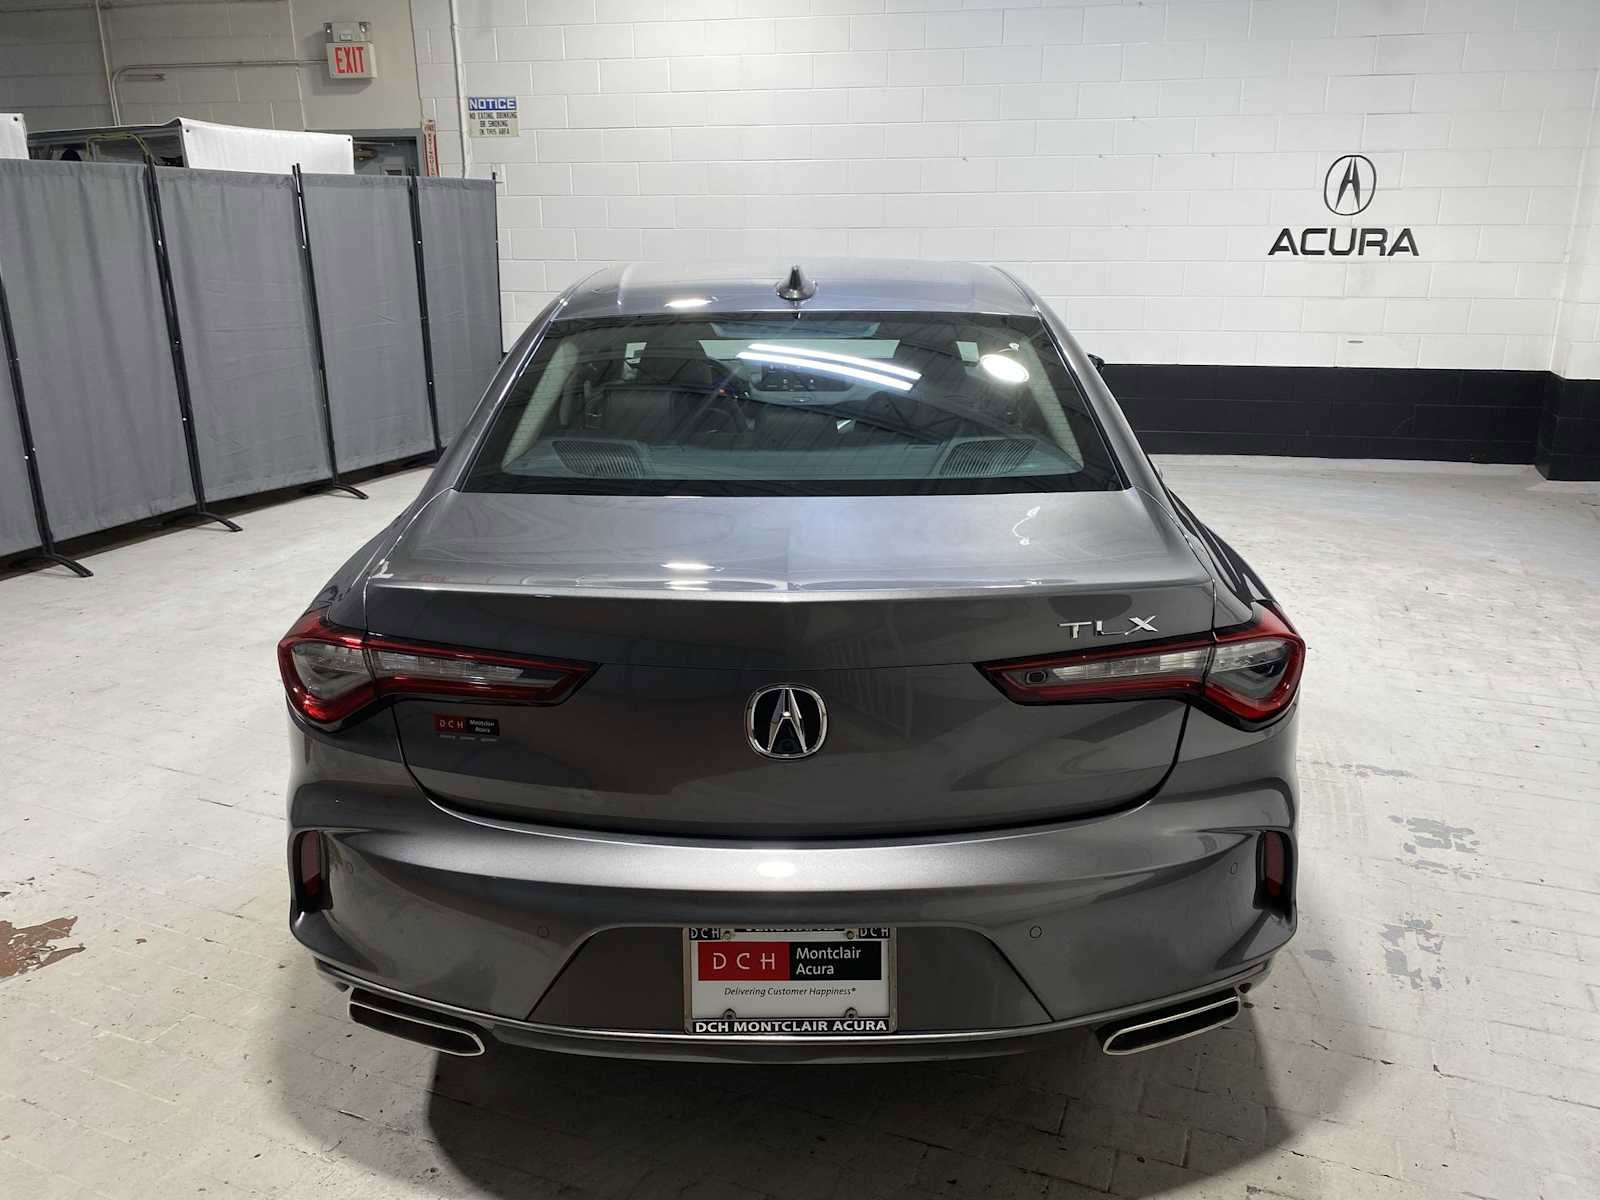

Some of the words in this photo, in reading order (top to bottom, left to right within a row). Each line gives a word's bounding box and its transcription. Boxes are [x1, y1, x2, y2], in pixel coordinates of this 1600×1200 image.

[335, 47, 364, 73] EXIT
[469, 98, 516, 110] NOTICE
[1267, 228, 1420, 256] ACURA
[1058, 615, 1159, 639] TLX
[690, 928, 720, 939] DCH
[860, 928, 889, 937] DCH
[795, 946, 861, 960] Montclair
[795, 963, 835, 975] Acura
[724, 987, 765, 997] Delivering
[767, 987, 808, 996] Customer
[695, 1022, 729, 1032] DCH
[733, 1021, 828, 1032] MONTCLAIR
[833, 1020, 887, 1031] ACURA
